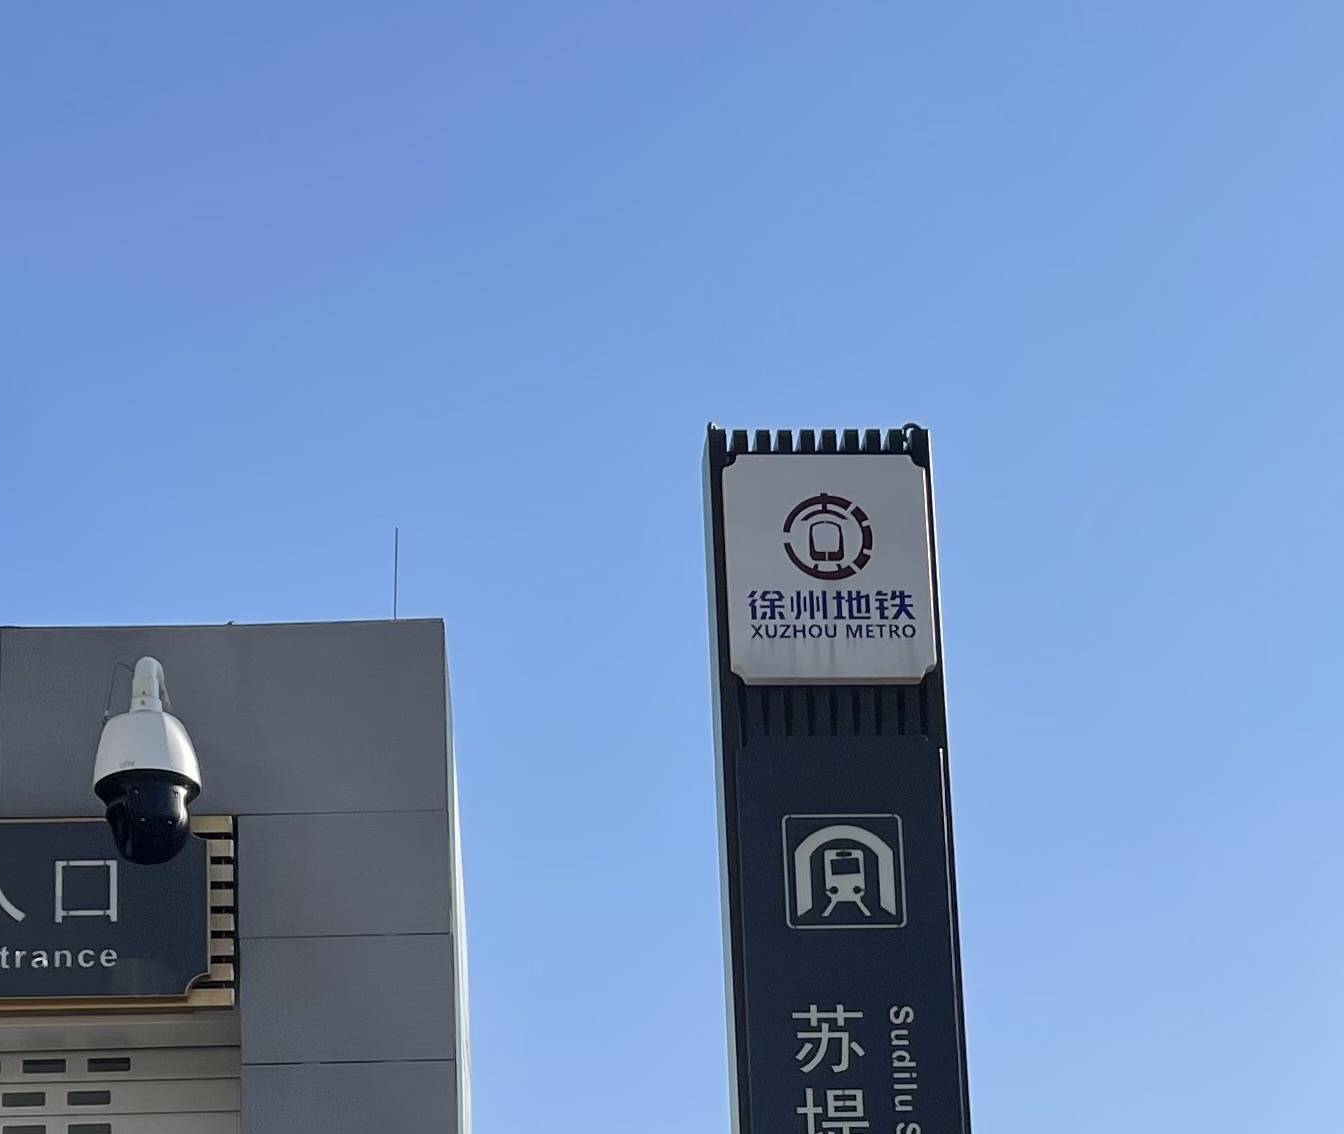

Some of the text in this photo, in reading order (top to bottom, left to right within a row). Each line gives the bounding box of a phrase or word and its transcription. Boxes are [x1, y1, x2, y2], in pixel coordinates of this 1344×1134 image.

[747, 590, 916, 621] 徐州地铁
[750, 623, 917, 639] XUZHOU METRO
[888, 1004, 919, 1112] Sudilu
